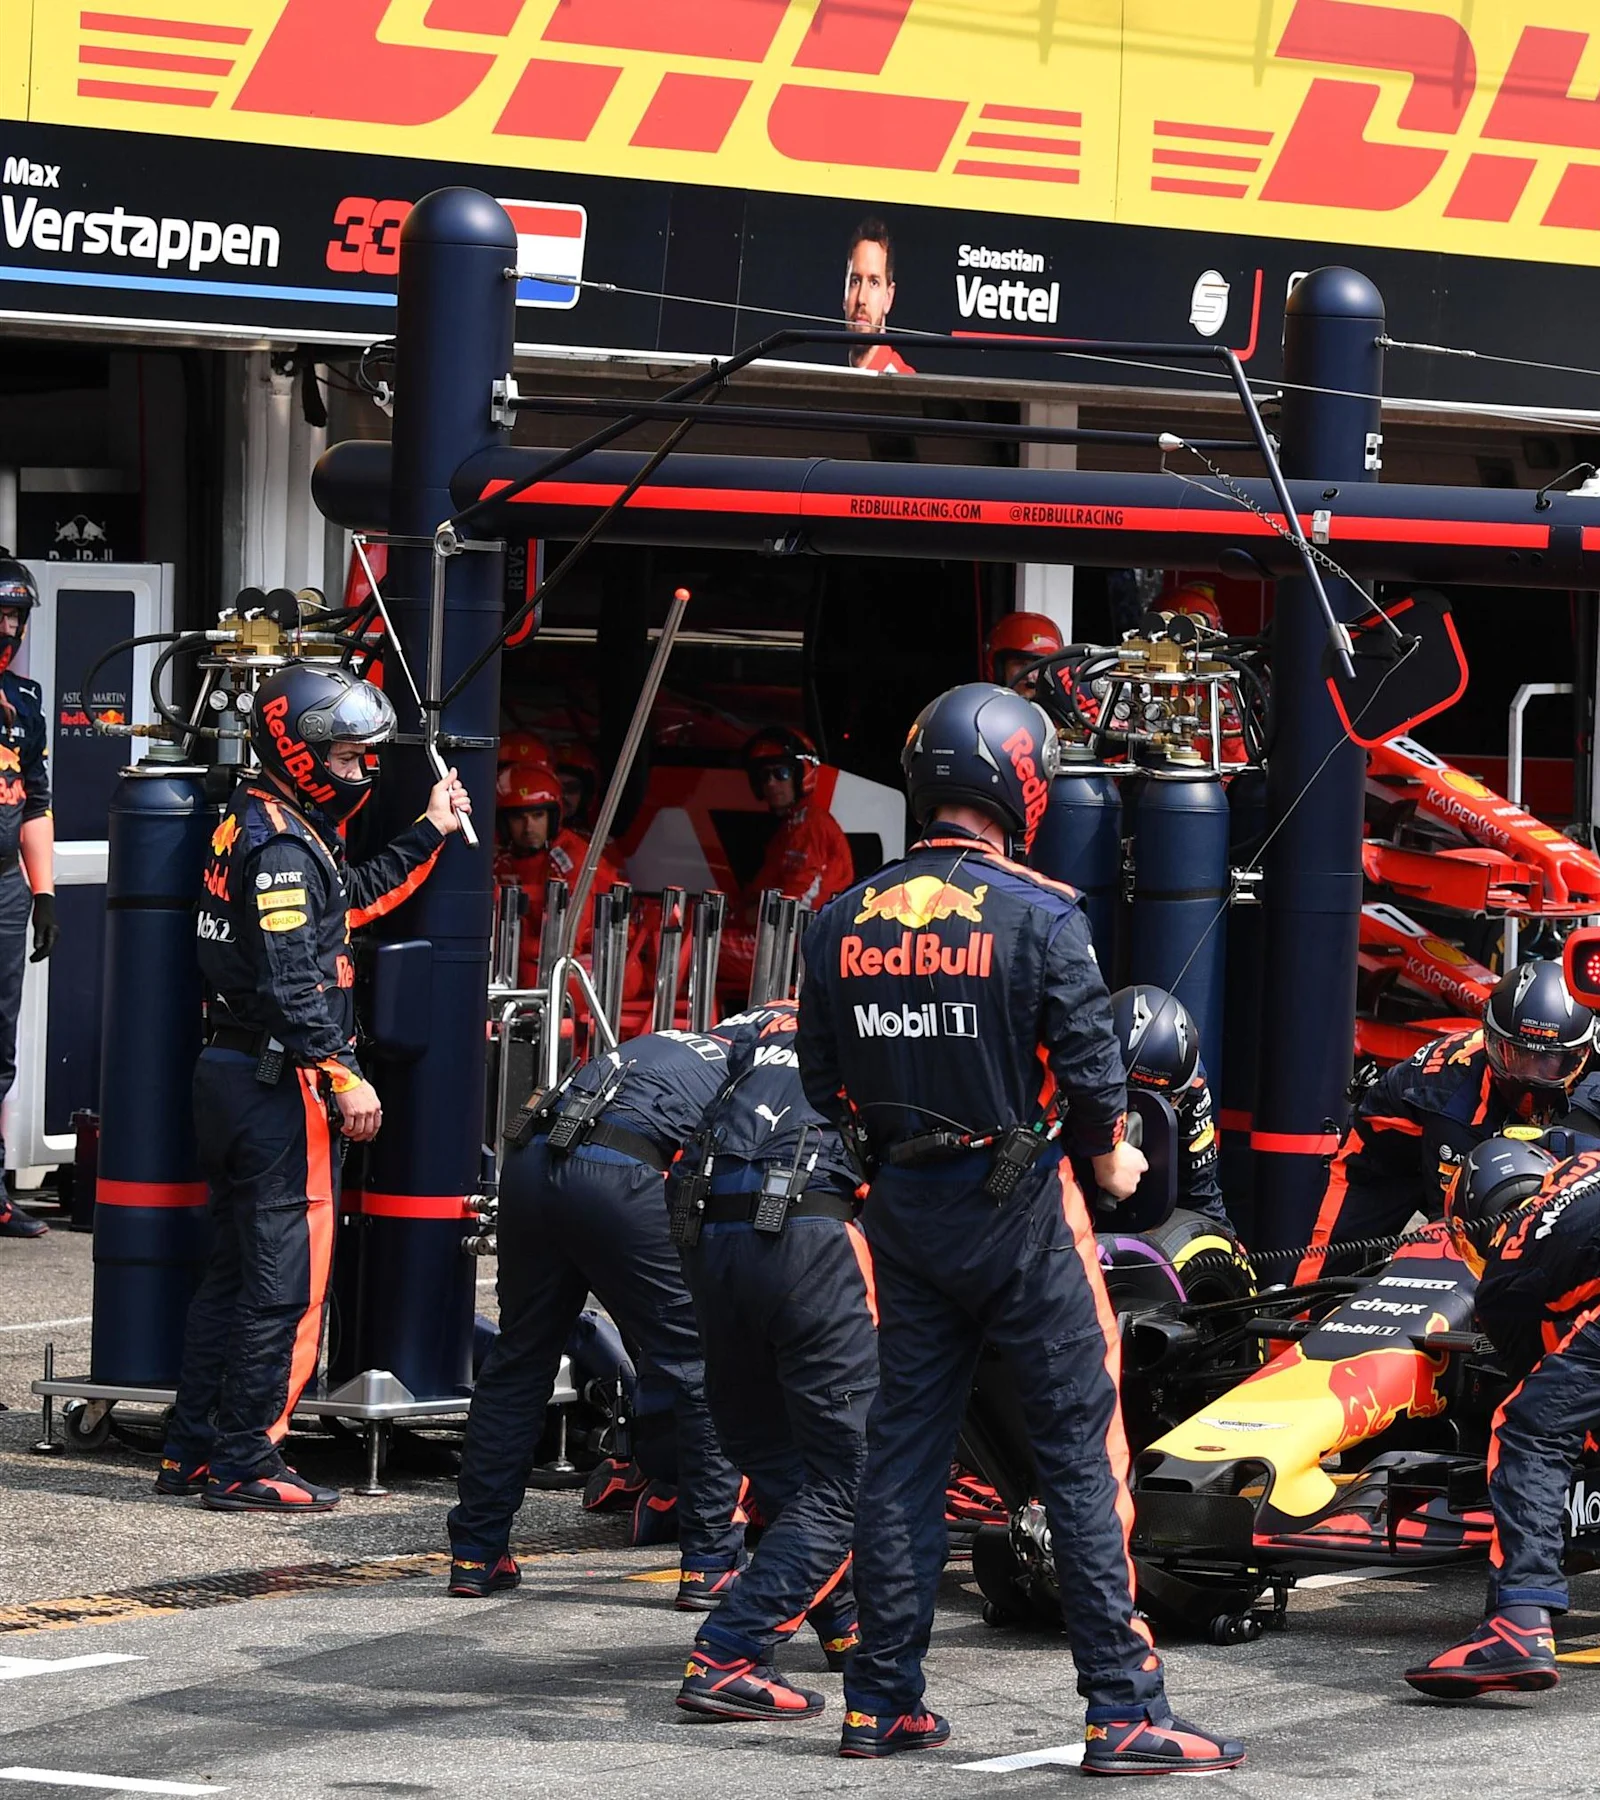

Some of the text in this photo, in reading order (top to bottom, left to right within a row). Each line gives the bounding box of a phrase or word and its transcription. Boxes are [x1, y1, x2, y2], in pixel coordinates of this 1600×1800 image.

[3, 156, 60, 189] Max
[2, 196, 401, 275] Verstappen 33
[957, 244, 1044, 273] Sebastian
[955, 275, 1059, 324] Vettel
[850, 498, 1124, 527] REDBULLRACING.COM @REDBULLRACING
[92, 693, 125, 704] MARTIN
[1426, 787, 1502, 840] KASPERSKY
[274, 872, 302, 884] AT&T
[336, 954, 354, 988] Re
[854, 1003, 937, 1038] Mobil
[1527, 1043, 1546, 1051] DITA
[1320, 1322, 1377, 1335] Mobil
